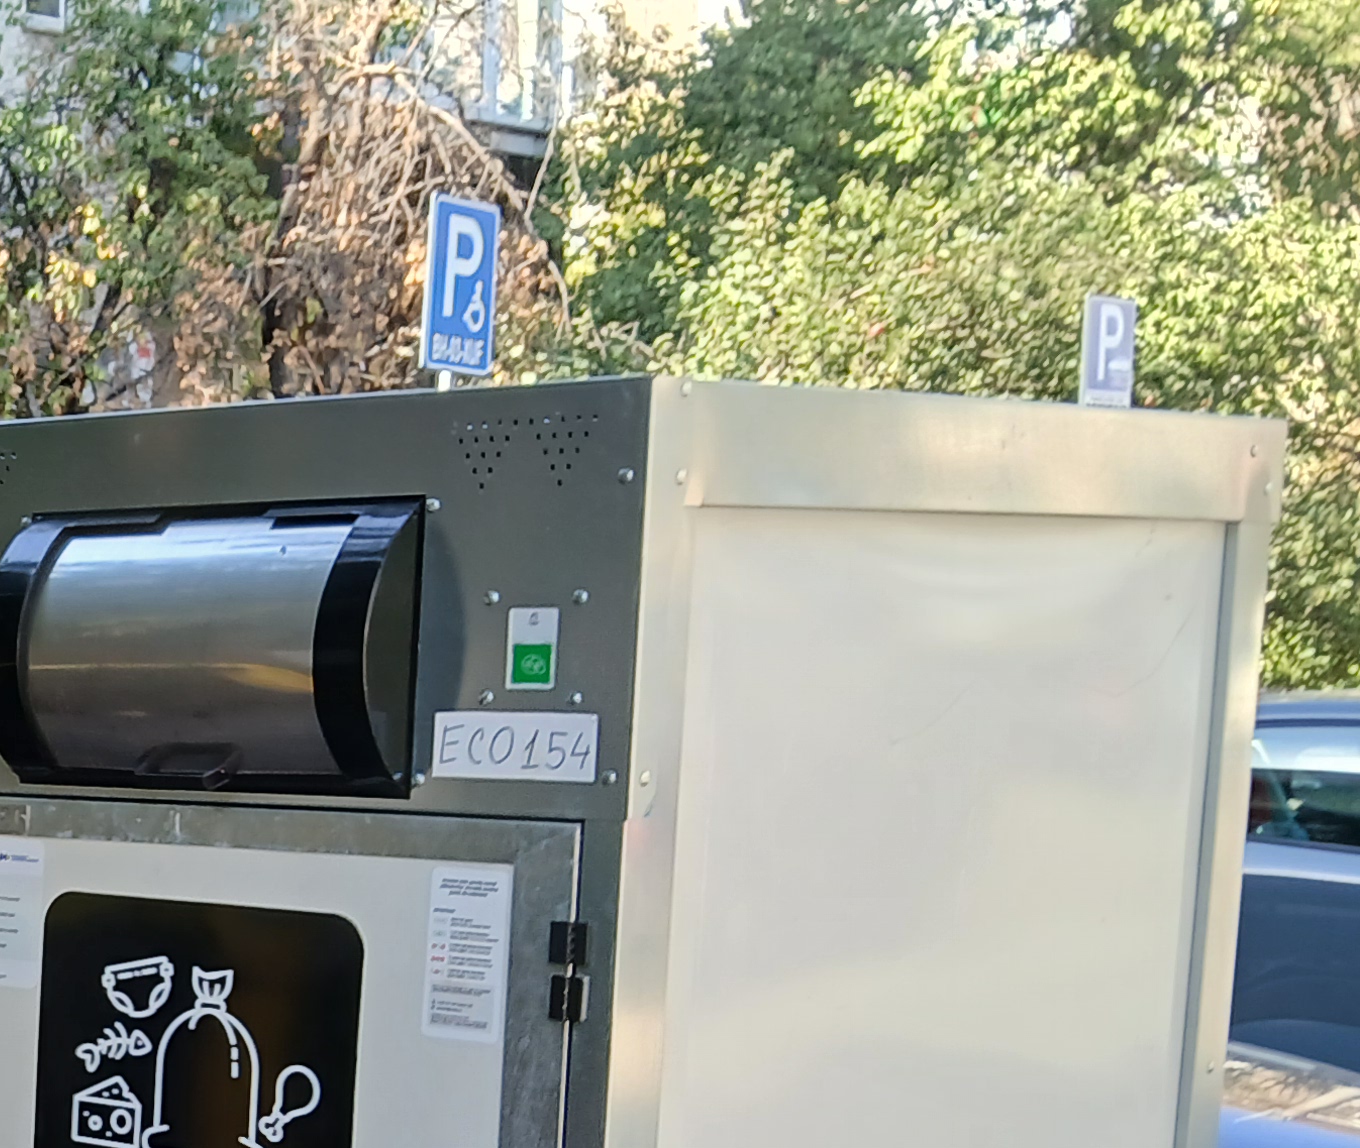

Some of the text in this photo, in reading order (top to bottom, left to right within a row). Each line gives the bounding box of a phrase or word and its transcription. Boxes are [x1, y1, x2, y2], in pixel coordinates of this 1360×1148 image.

[442, 213, 484, 318] P
[1097, 303, 1125, 381] P
[438, 723, 592, 771] ECO154
